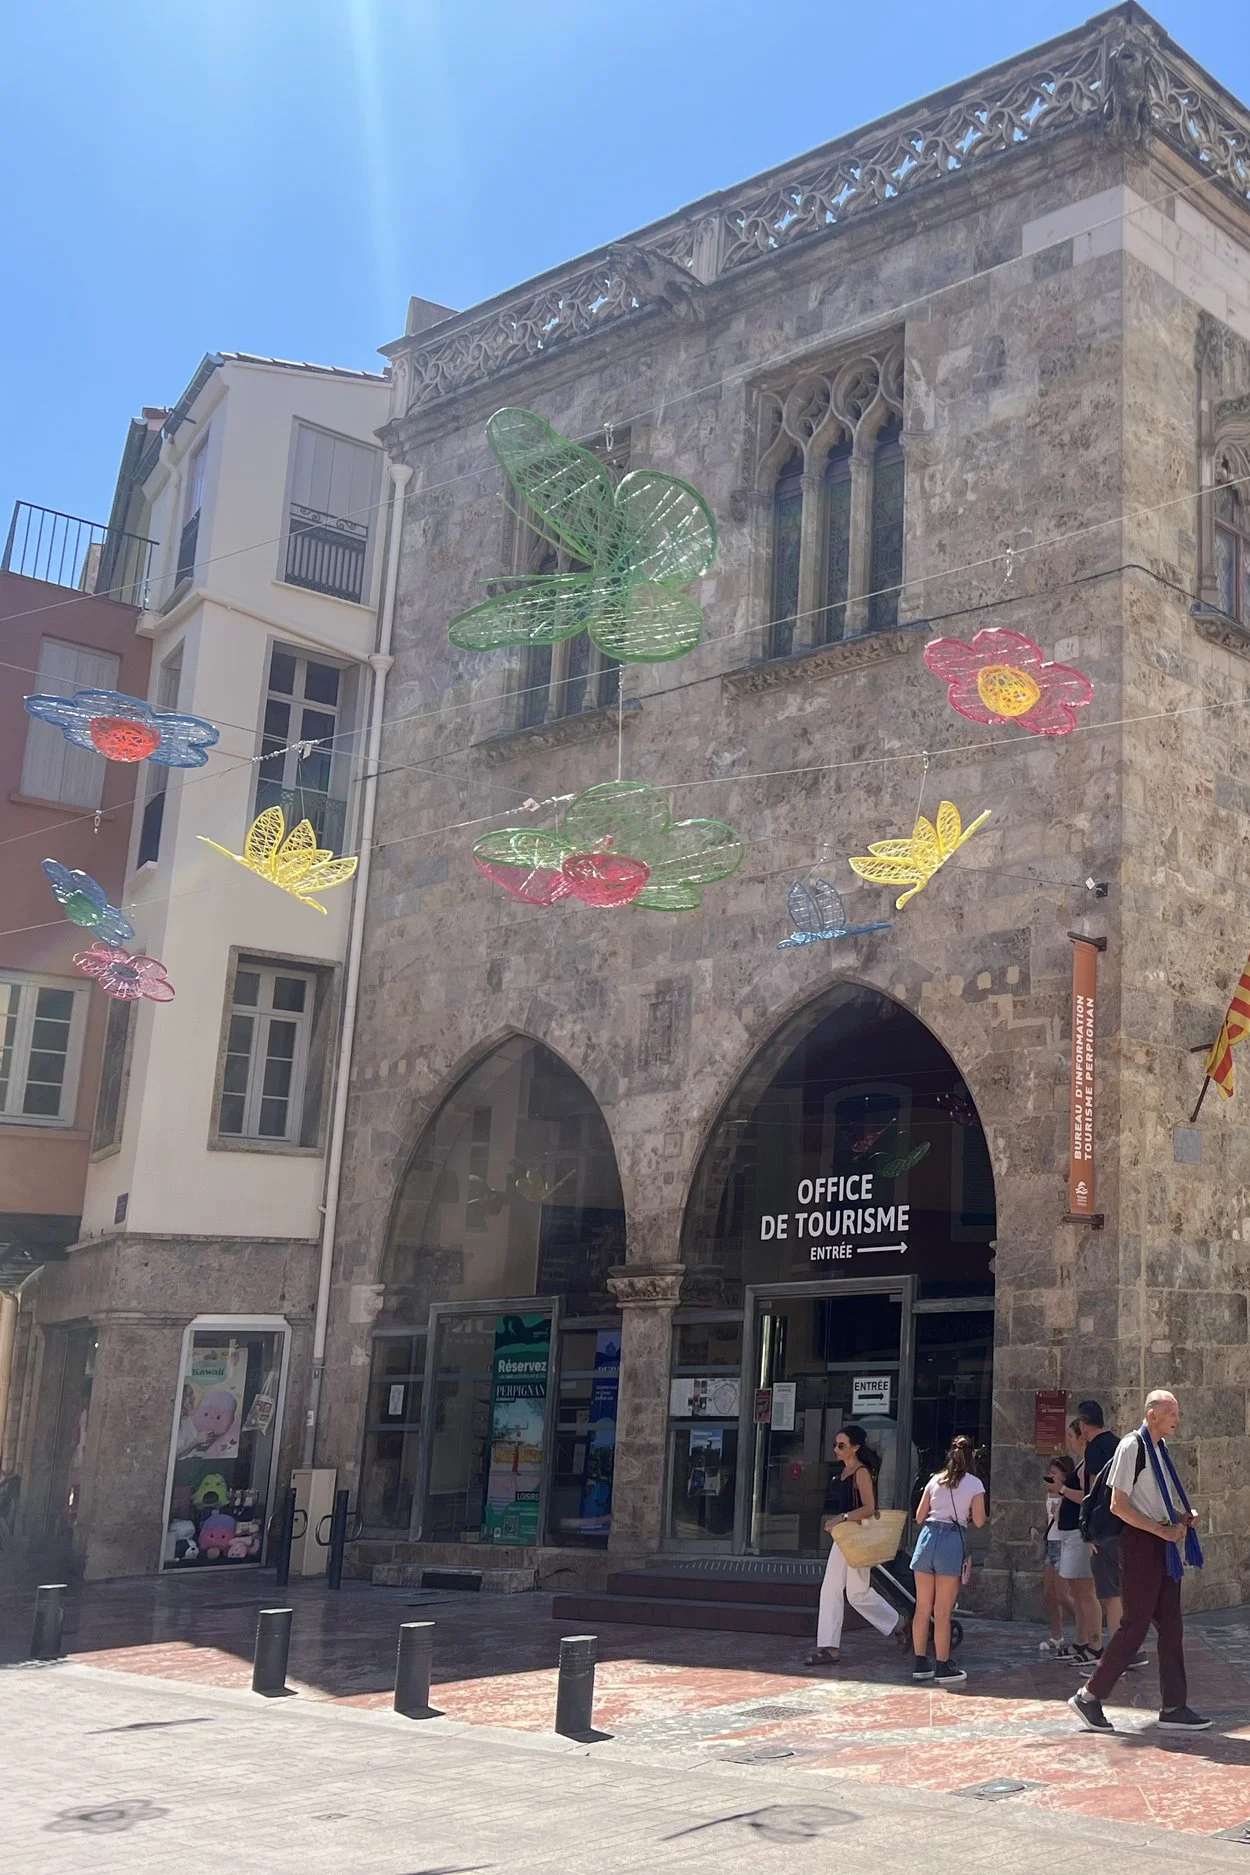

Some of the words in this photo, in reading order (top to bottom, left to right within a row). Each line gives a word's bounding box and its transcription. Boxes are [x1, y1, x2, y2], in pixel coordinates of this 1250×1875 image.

[1075, 995, 1084, 1097] D'INFORMATION
[1085, 997, 1094, 1082] PERPIGNAN
[1074, 1104, 1083, 1160] BUREAU
[1085, 1086, 1093, 1161] TOURISME
[798, 1173, 873, 1204] OFFICE
[760, 1214, 788, 1240] DE
[795, 1204, 910, 1238] TOURISME
[810, 1241, 853, 1260] ENTRÉE
[192, 1367, 225, 1376] Kawaii
[498, 1359, 547, 1373] Réservez
[497, 1384, 545, 1397] PERPIGNAN
[854, 1380, 889, 1391] ENTRÉE
[516, 1492, 540, 1501] LOISIRS
